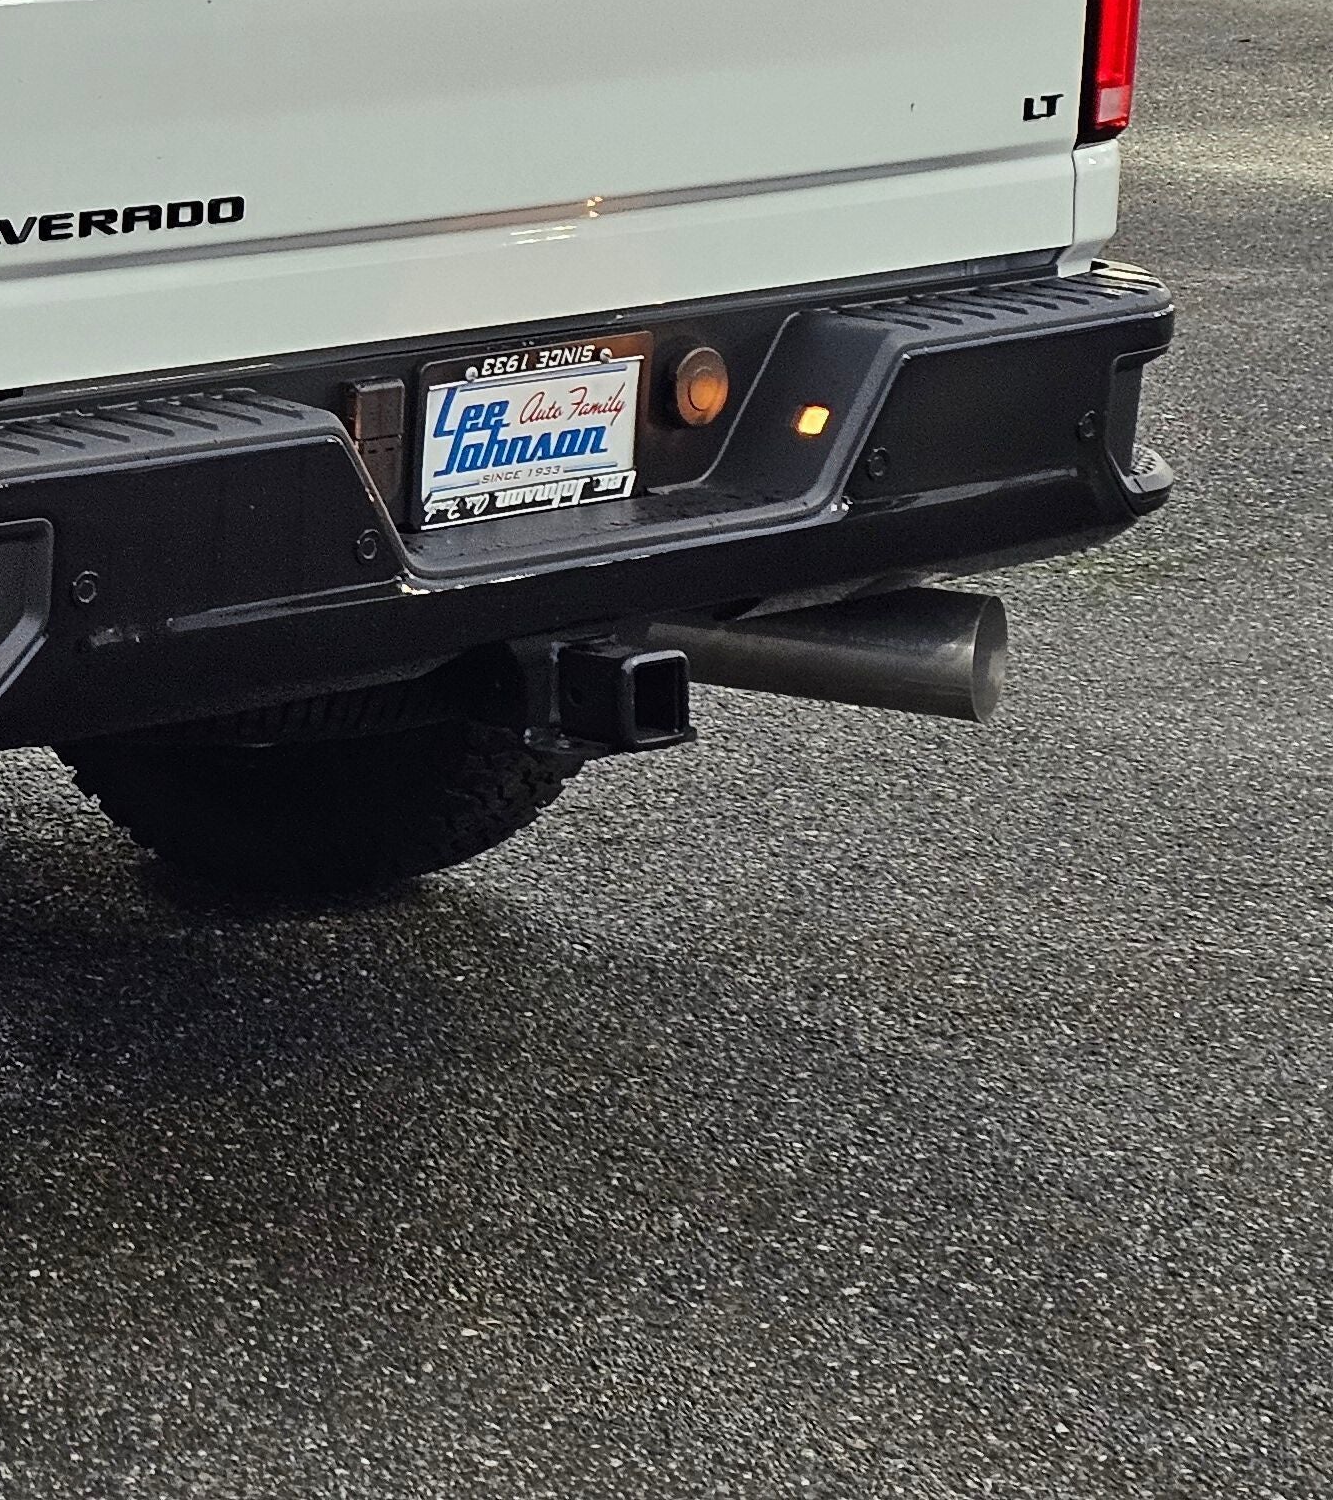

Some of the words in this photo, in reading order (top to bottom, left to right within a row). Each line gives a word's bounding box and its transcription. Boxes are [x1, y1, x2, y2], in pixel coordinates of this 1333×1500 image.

[1022, 93, 1064, 121] LT
[481, 354, 528, 376] 1933
[535, 345, 595, 369] SINCE
[433, 386, 511, 438] Lee
[519, 392, 562, 425] Auto
[567, 383, 627, 427] Family
[433, 424, 608, 478] Johnson
[481, 470, 522, 484] SINCE
[527, 465, 562, 478] 1933
